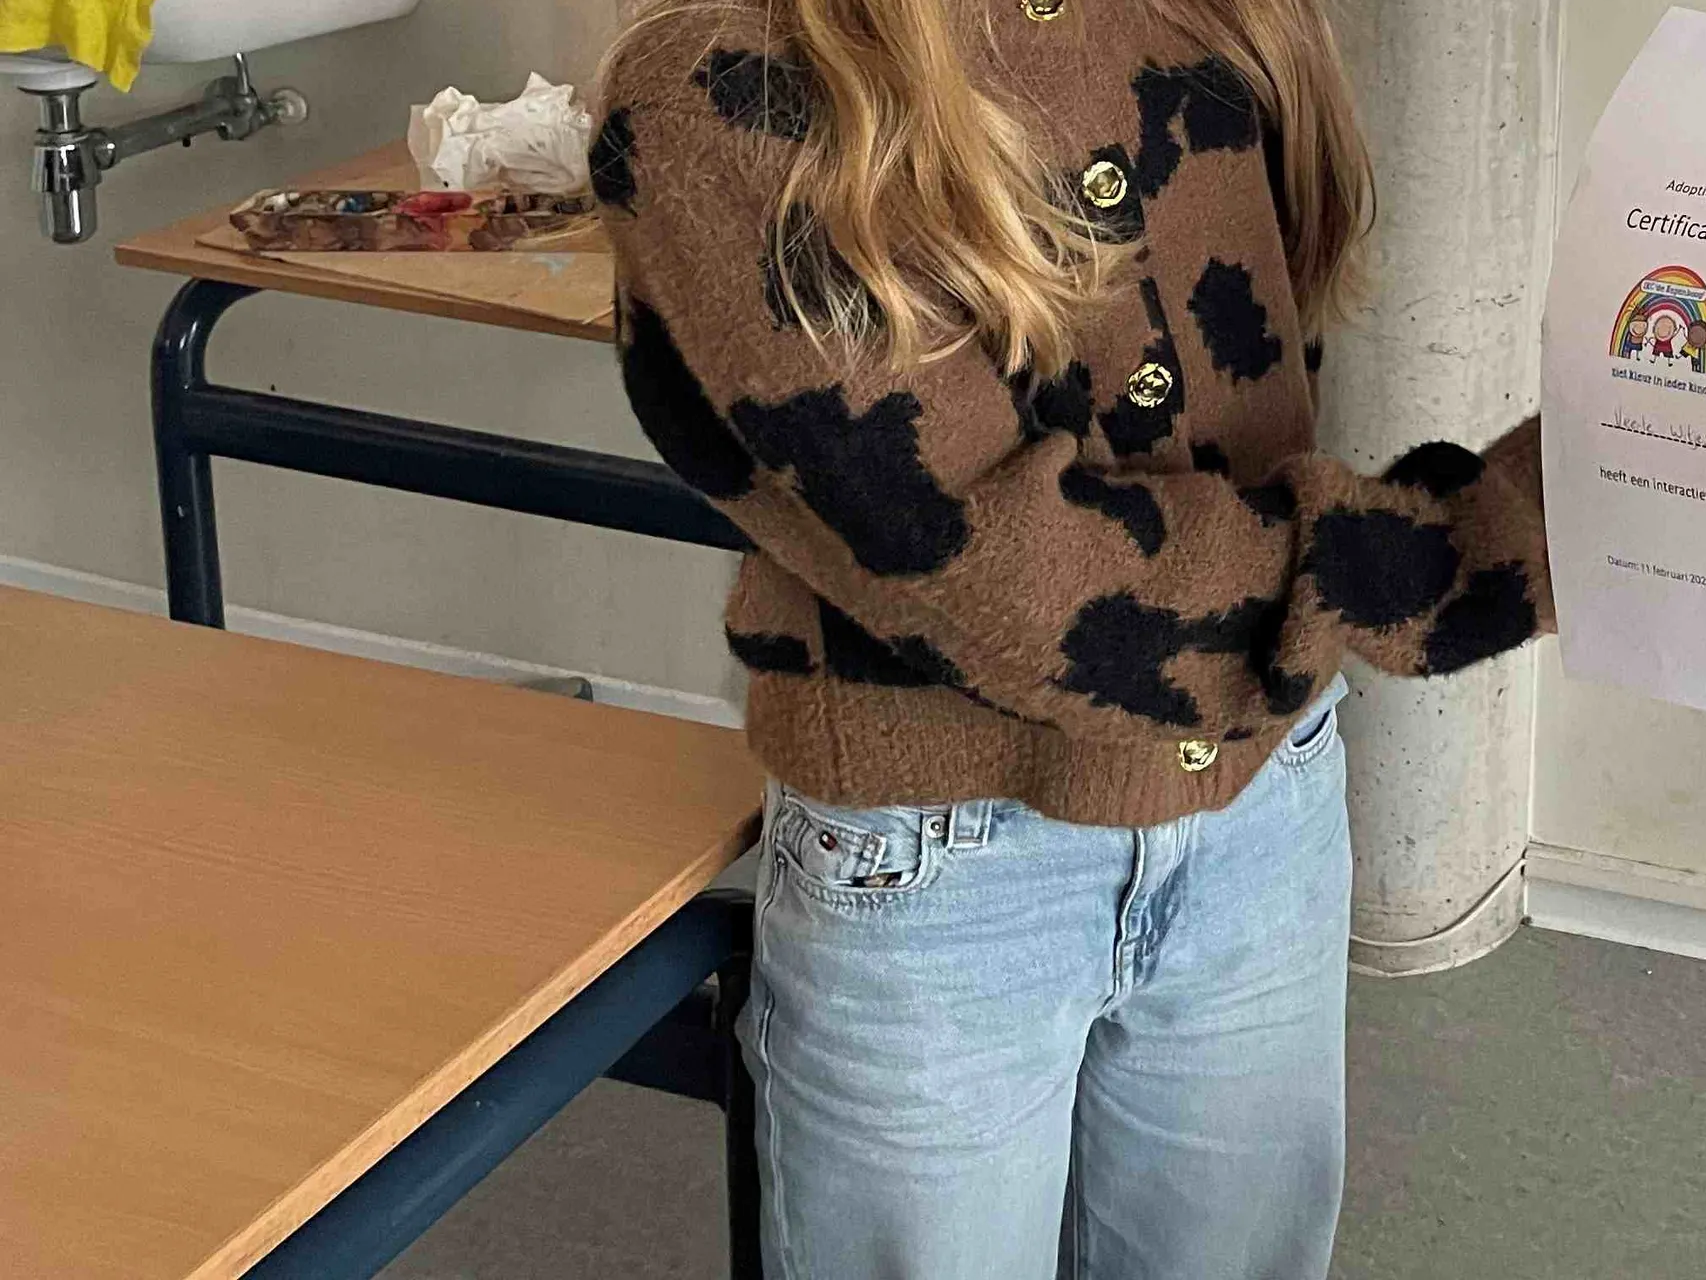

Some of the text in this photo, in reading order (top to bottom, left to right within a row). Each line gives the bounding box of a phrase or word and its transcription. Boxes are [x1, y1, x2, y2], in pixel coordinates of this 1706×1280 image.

[1600, 466, 1627, 483] heeft
[1630, 475, 1650, 489] een
[1653, 565, 1688, 582] februari
